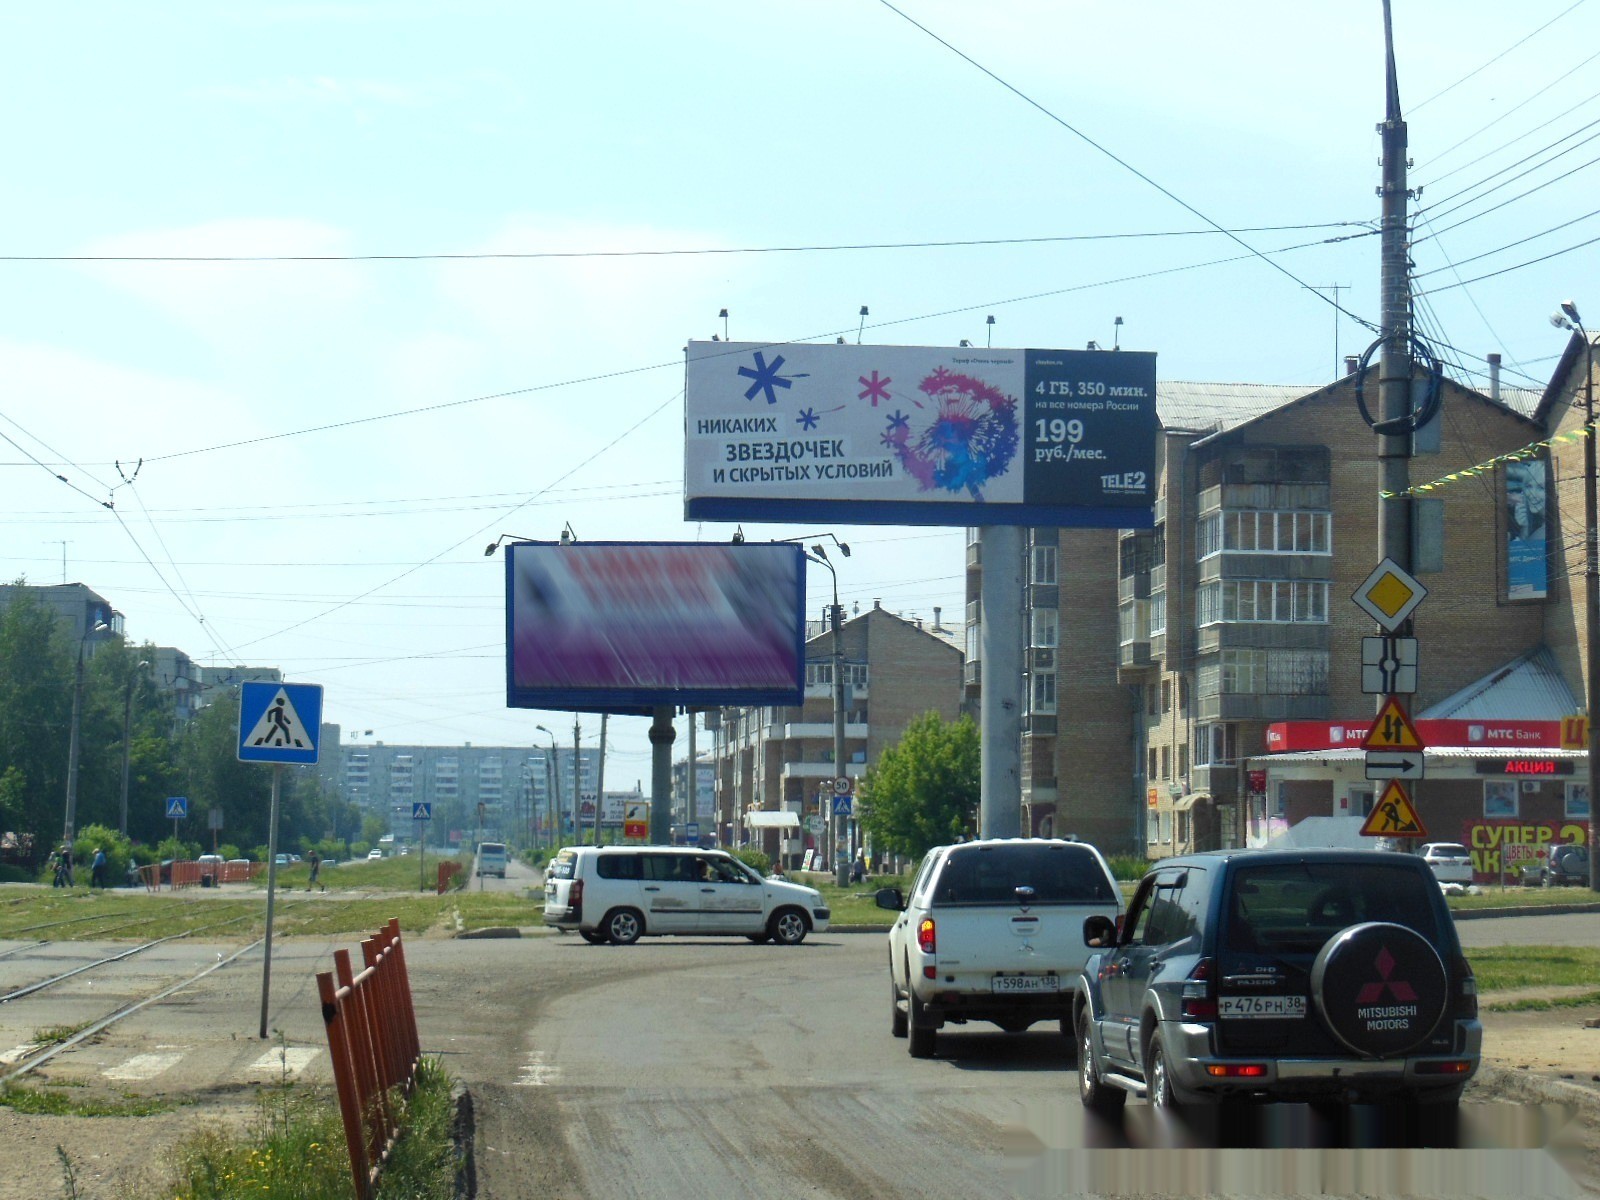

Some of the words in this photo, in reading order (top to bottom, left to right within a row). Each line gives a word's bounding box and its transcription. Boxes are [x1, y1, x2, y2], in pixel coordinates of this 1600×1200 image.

[1035, 380, 1046, 395] 4
[1049, 381, 1073, 398] ГБ,
[1077, 381, 1106, 396] 350
[1109, 386, 1148, 398] мин.
[1035, 401, 1047, 409] на
[1049, 401, 1066, 409] все
[1067, 402, 1104, 412] номера
[1106, 400, 1140, 411] России
[697, 417, 778, 435] НИКАКИХ
[1035, 418, 1084, 444] 199
[725, 439, 845, 463] ЗВЕЗДОЧЕК
[1034, 443, 1107, 463] руб./мес.
[713, 468, 725, 484] И
[729, 464, 810, 483] СКРЫТЫХ
[814, 459, 894, 480] УСЛОВИЙ
[1100, 471, 1146, 489] TELE2
[1487, 729, 1514, 740] МТС
[1516, 729, 1541, 740] Банк
[1504, 760, 1556, 775] АКЦИЯ
[836, 781, 847, 790] 50
[1471, 825, 1553, 848] СУПЕР
[1357, 1005, 1417, 1019] MITSUBISHI
[1366, 1018, 1409, 1031] MOTORS
